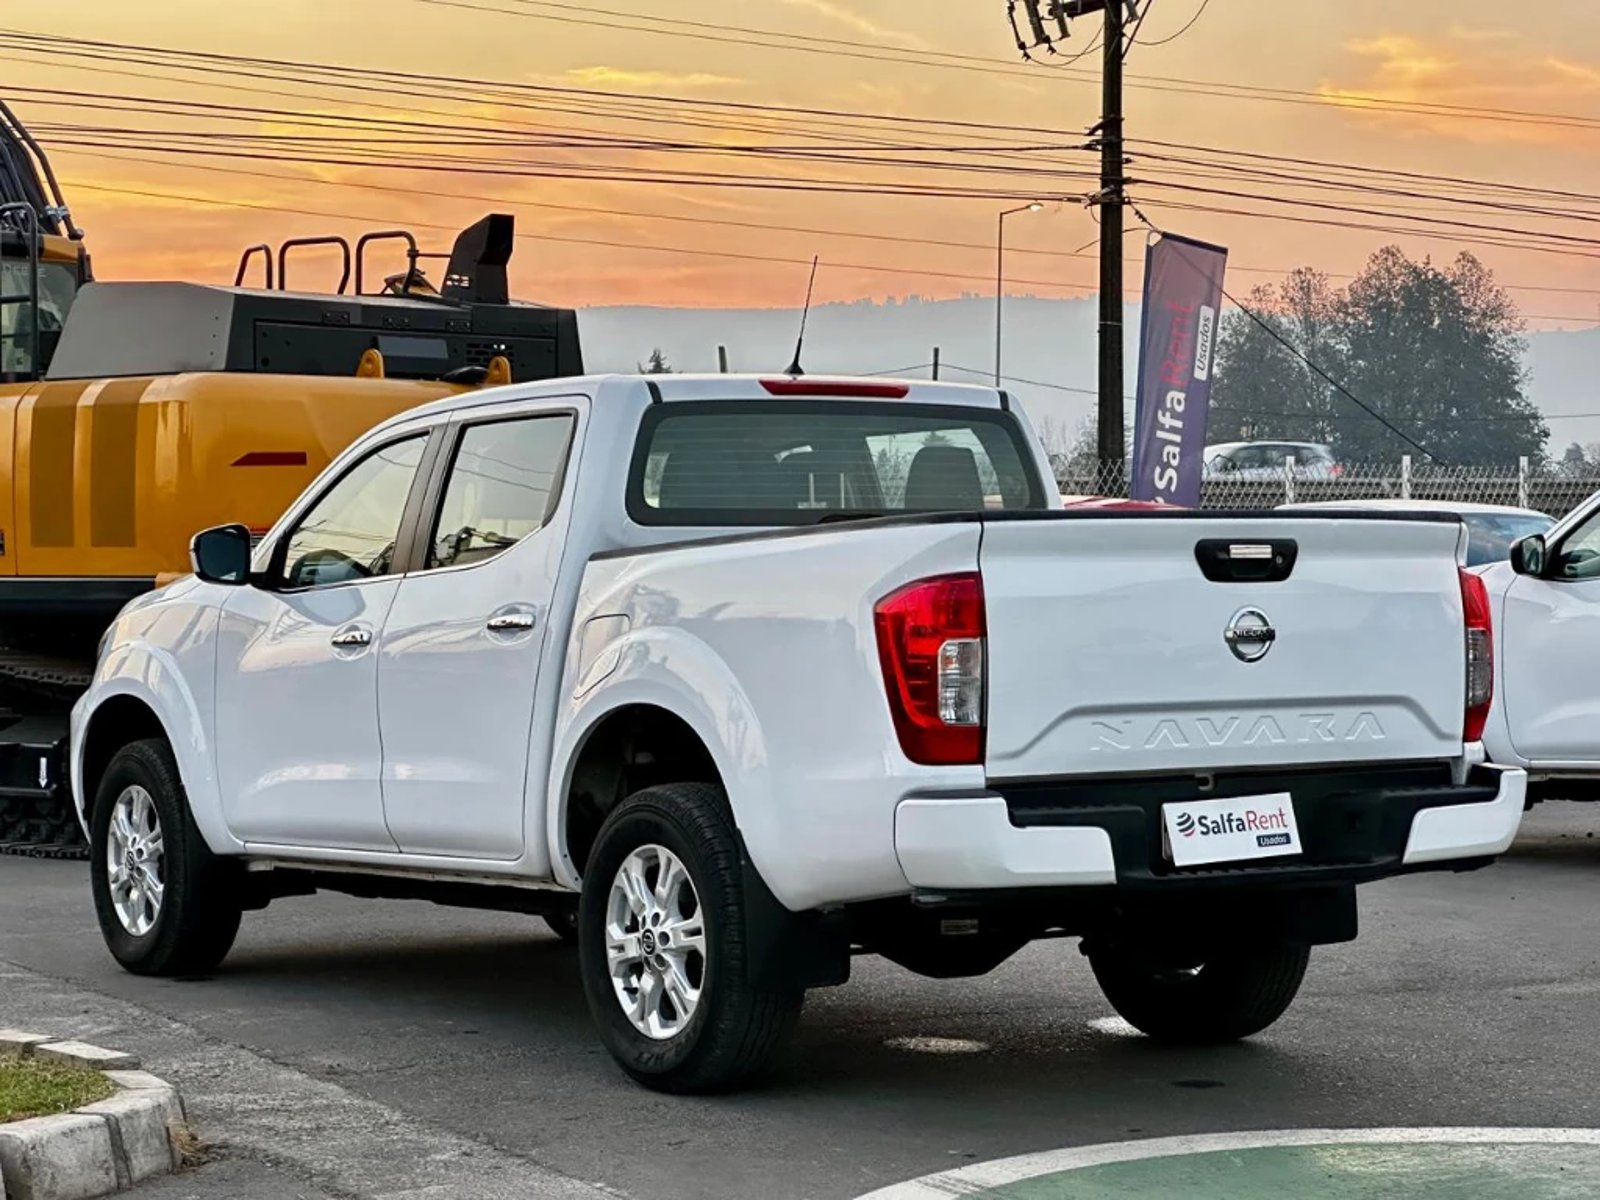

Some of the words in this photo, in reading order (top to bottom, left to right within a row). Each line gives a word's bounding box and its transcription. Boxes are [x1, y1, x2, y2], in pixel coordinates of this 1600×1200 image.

[1196, 315, 1212, 371] Usados
[1154, 302, 1195, 493] SalfaRent
[1090, 712, 1386, 750] NAVARA
[1198, 807, 1288, 836] SalfaRent
